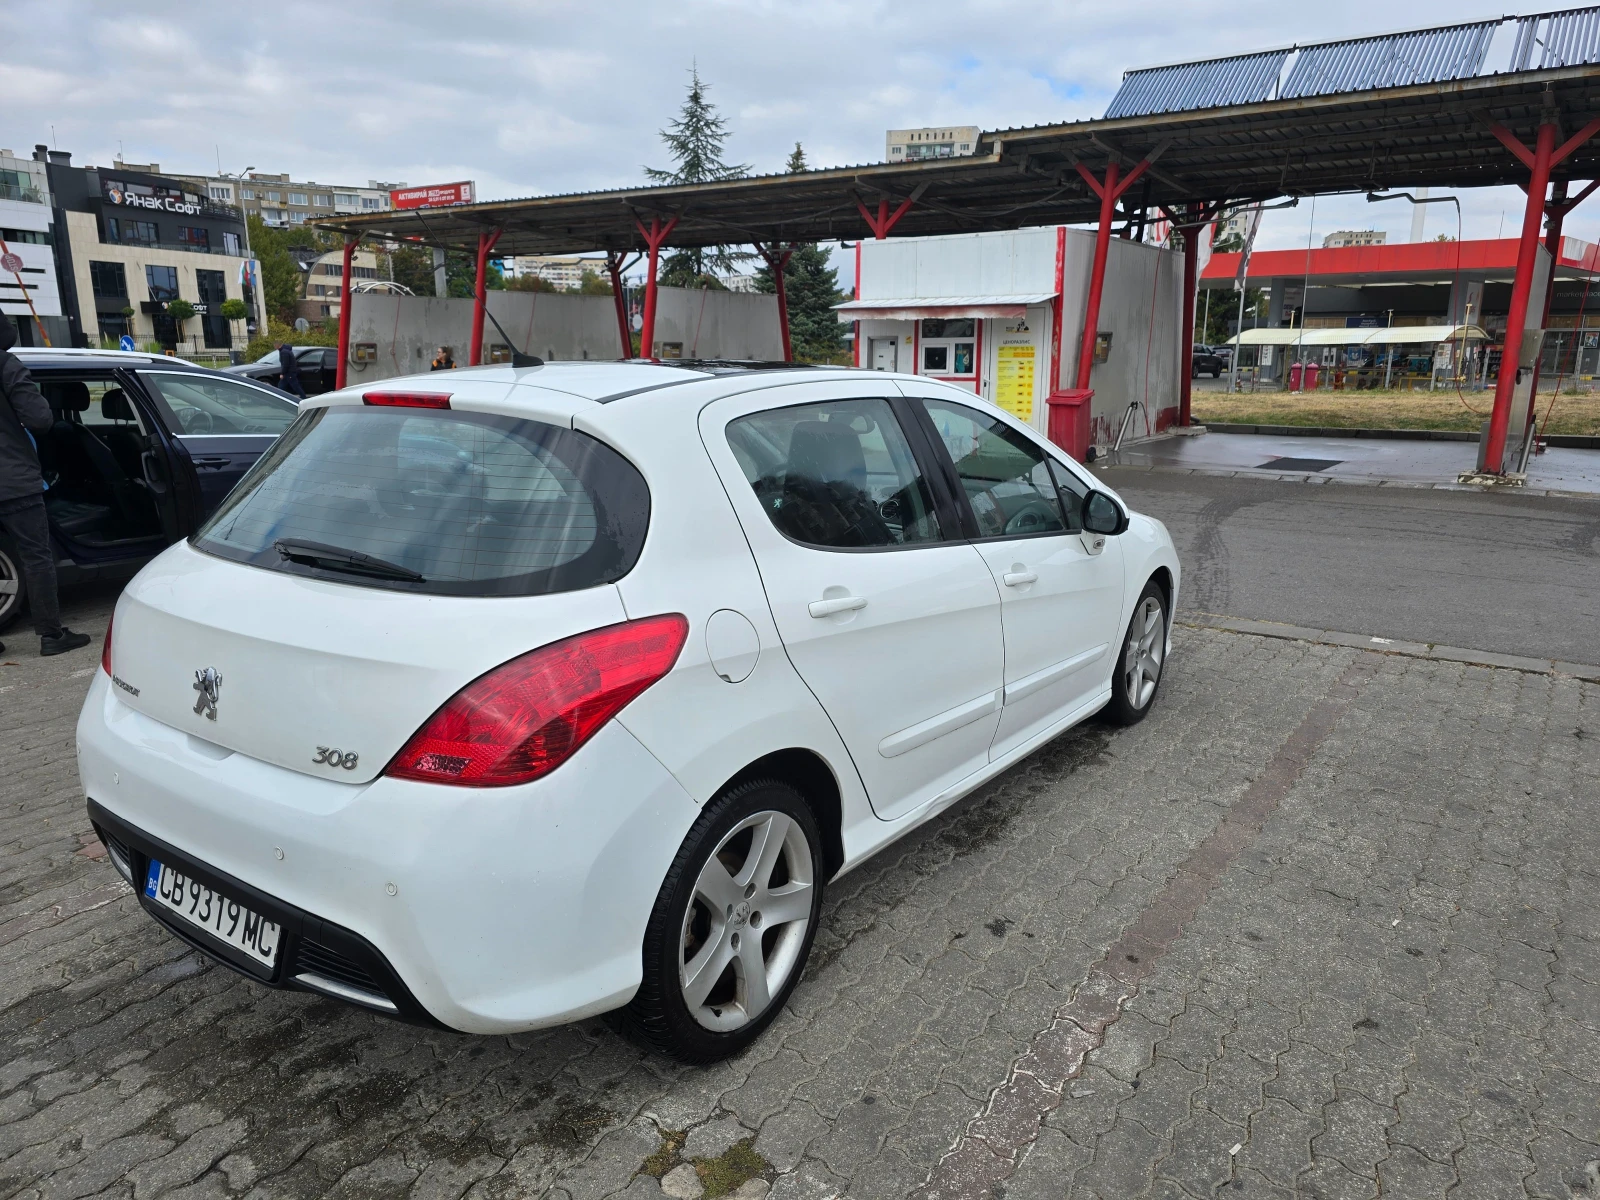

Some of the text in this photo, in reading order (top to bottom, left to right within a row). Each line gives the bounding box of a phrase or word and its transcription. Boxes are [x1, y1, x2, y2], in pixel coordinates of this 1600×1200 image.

[124, 191, 201, 215] Янак Софт
[5, 254, 19, 271] STOP
[311, 745, 359, 771] 308
[148, 877, 158, 891] BG
